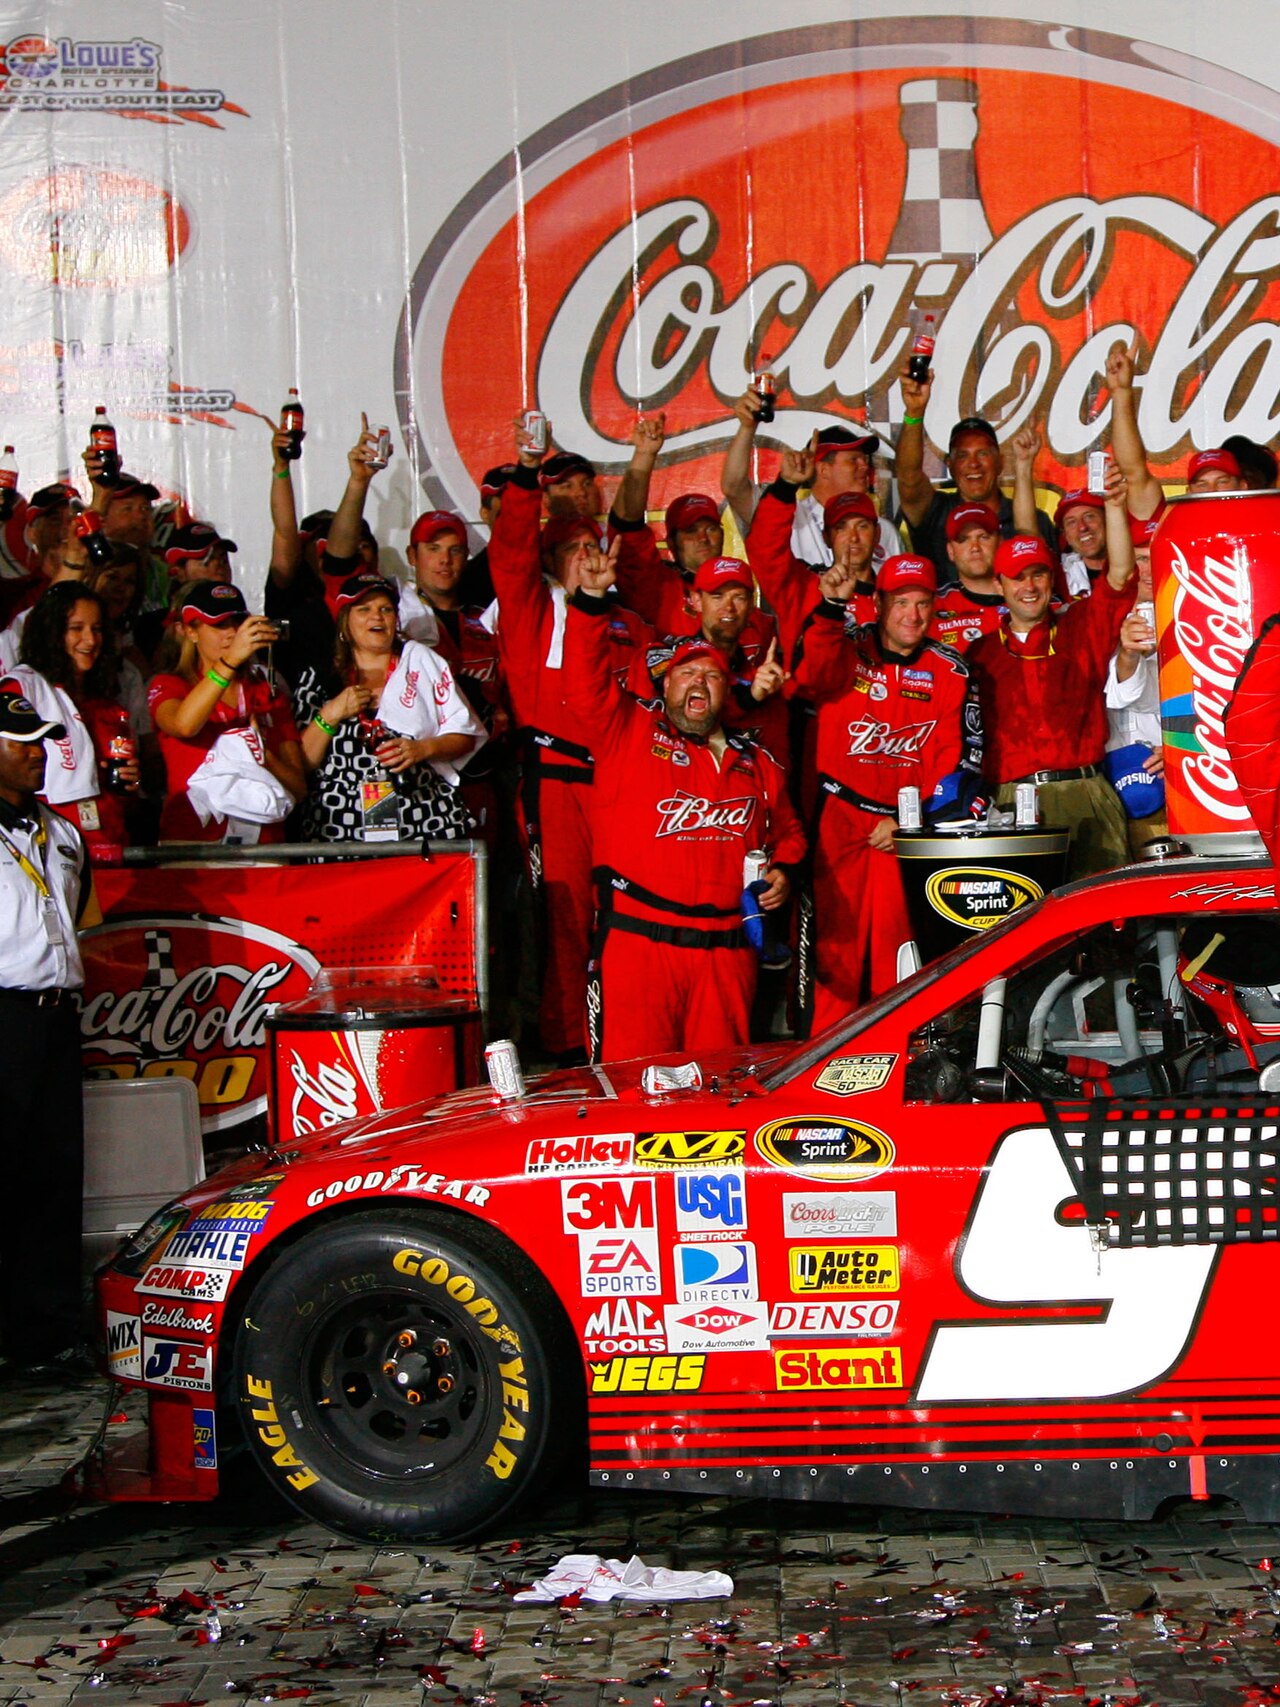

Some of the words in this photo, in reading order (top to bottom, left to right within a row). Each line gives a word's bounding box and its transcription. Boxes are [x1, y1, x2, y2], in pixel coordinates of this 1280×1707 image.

[61, 41, 155, 67] LOWE'S
[10, 78, 154, 88] CHARLOTTE
[104, 93, 219, 105] SOUTHEAST
[1170, 541, 1254, 821] Coca-Cola
[848, 720, 929, 754] Bud
[656, 797, 750, 831] Bud
[958, 880, 1002, 895] NASCAR
[966, 896, 1009, 913] Sprint
[972, 917, 996, 925] CUP
[829, 1057, 861, 1067] RACE
[863, 1056, 891, 1065] CAR
[837, 1081, 856, 1091] 60
[795, 1128, 845, 1141] NASCAR
[529, 1137, 631, 1166] Holley
[801, 1141, 848, 1159] Sprint
[528, 1165, 550, 1173] HP
[307, 1164, 491, 1208] GOODYEAR
[566, 1180, 654, 1230] 3M
[677, 1173, 744, 1227] USG
[196, 1201, 276, 1220] MOOG
[790, 1202, 837, 1222] Coors
[229, 1220, 263, 1232] PARTS
[804, 1222, 875, 1234] POLE
[679, 1231, 747, 1242] SHEETROCK
[587, 1239, 655, 1275] EA
[821, 1251, 879, 1268] Auto
[142, 1267, 206, 1290] COMP
[585, 1275, 658, 1293] SPORTS
[817, 1267, 893, 1286] Meter
[181, 1287, 215, 1298] CAMS
[683, 1289, 751, 1302] DIRECTV
[141, 1303, 214, 1334] Edelbrock
[584, 1298, 665, 1338] MAC
[772, 1304, 895, 1331] DENSO
[107, 1319, 139, 1353] WIX
[681, 1340, 704, 1349] Dow
[704, 1339, 756, 1348] Automotive
[584, 1338, 666, 1354] TOOLS
[145, 1342, 208, 1380] JE
[392, 1248, 529, 1480] GOODYEAR
[780, 1350, 898, 1386] Stant
[592, 1355, 706, 1392] JEGS
[163, 1376, 211, 1391] PISTONS
[246, 1374, 321, 1491] EAGLE
